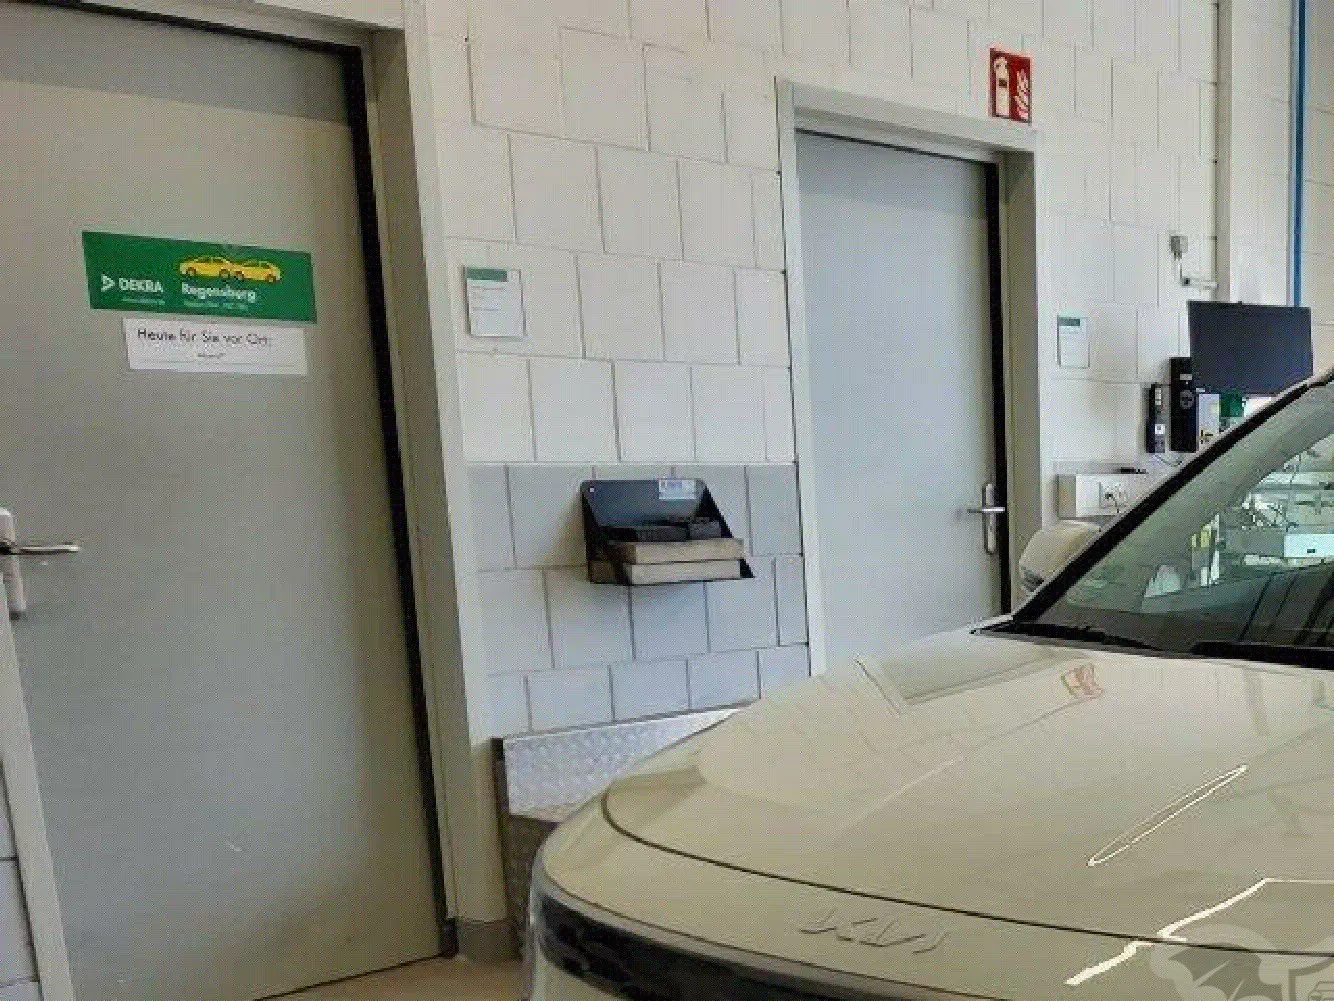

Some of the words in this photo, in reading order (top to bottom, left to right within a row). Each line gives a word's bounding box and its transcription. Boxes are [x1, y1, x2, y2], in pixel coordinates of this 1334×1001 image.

[118, 277, 164, 293] DEKRA
[181, 282, 257, 303] Regensburg
[137, 328, 177, 341] Heute
[202, 330, 220, 343] Sie
